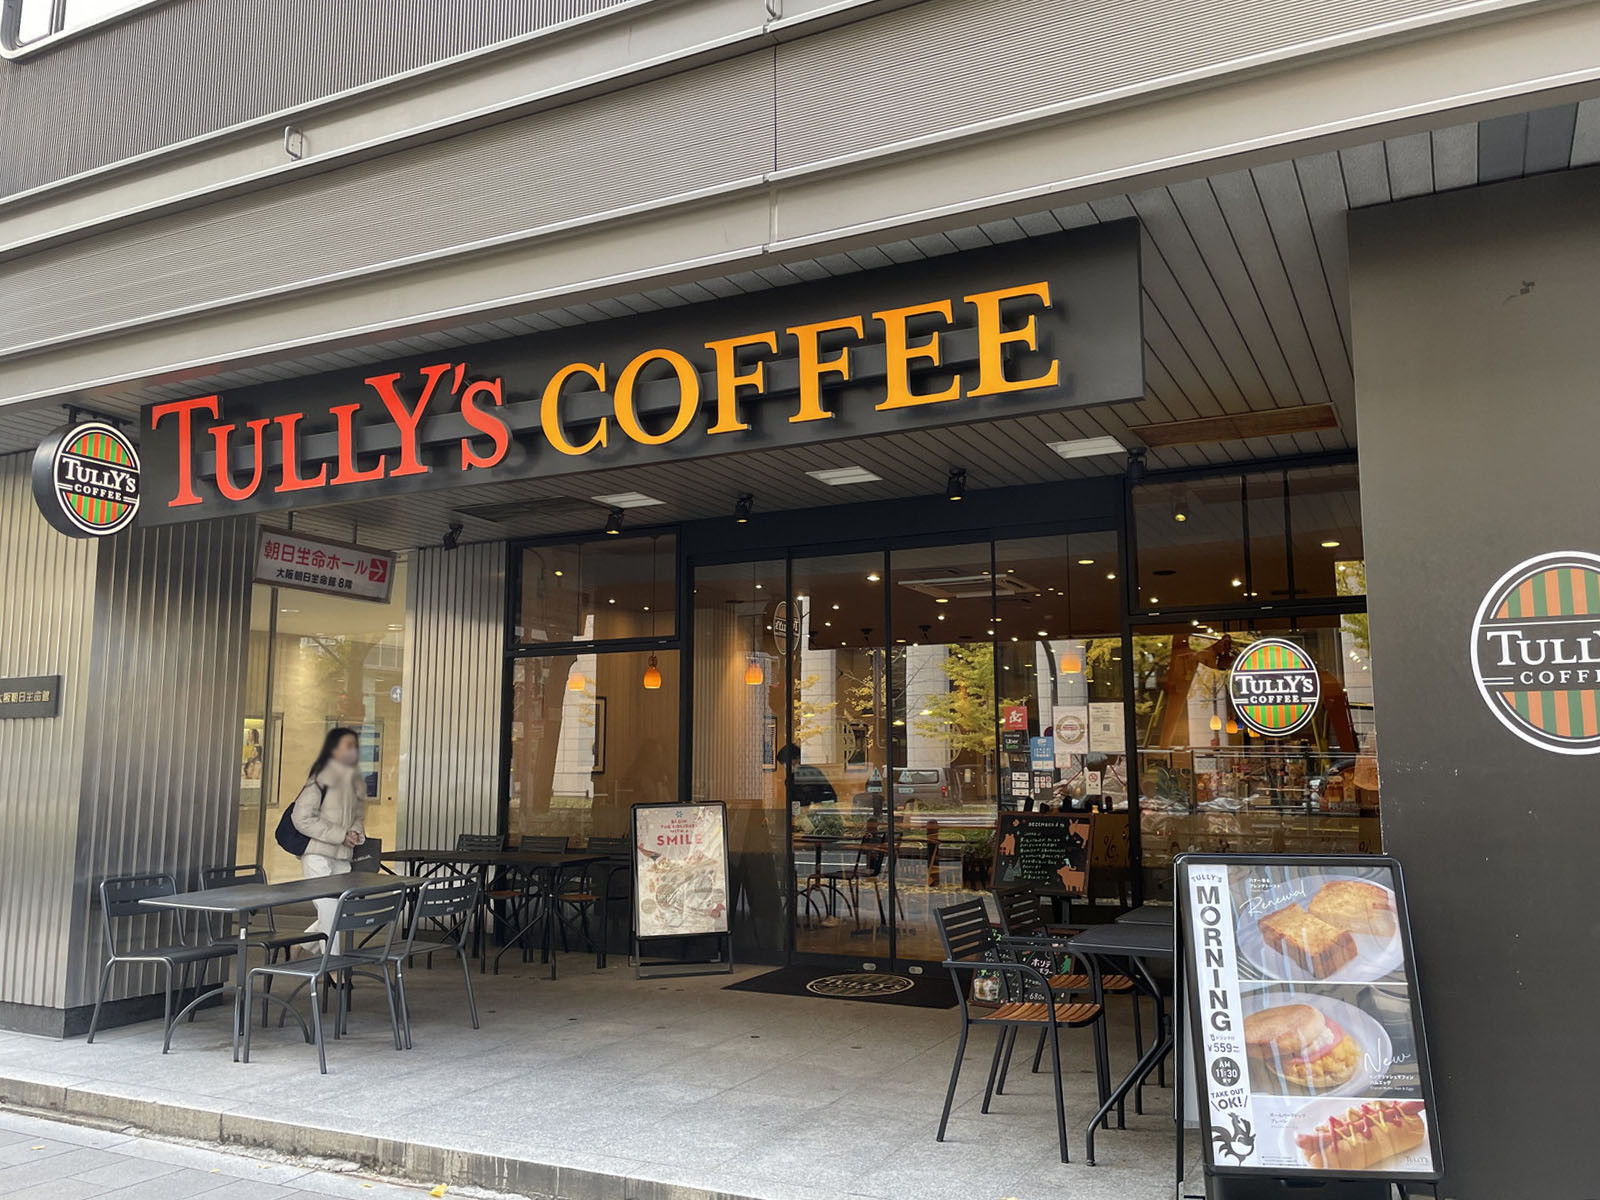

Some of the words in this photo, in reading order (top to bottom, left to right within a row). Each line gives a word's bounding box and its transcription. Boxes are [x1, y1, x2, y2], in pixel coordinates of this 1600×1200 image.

[539, 281, 1061, 457] COFFEE
[62, 457, 136, 493] TULLY'S
[74, 484, 122, 501] COFFEE
[263, 540, 368, 575] 朝日生命ホール
[1487, 630, 1600, 666] TULL
[1235, 675, 1314, 695] TULLY'S
[1249, 695, 1300, 704] COFFEE
[657, 834, 703, 846] SMILE
[1190, 872, 1223, 883] TULLY'S
[1239, 879, 1308, 917] Renewal
[1196, 885, 1232, 1033] MORNING
[1363, 1037, 1412, 1073] New
[1215, 1068, 1238, 1078] 11:30
[1210, 1090, 1229, 1099] TAKE
[1230, 1088, 1245, 1096] OUT
[1218, 1096, 1243, 1110] OK!
